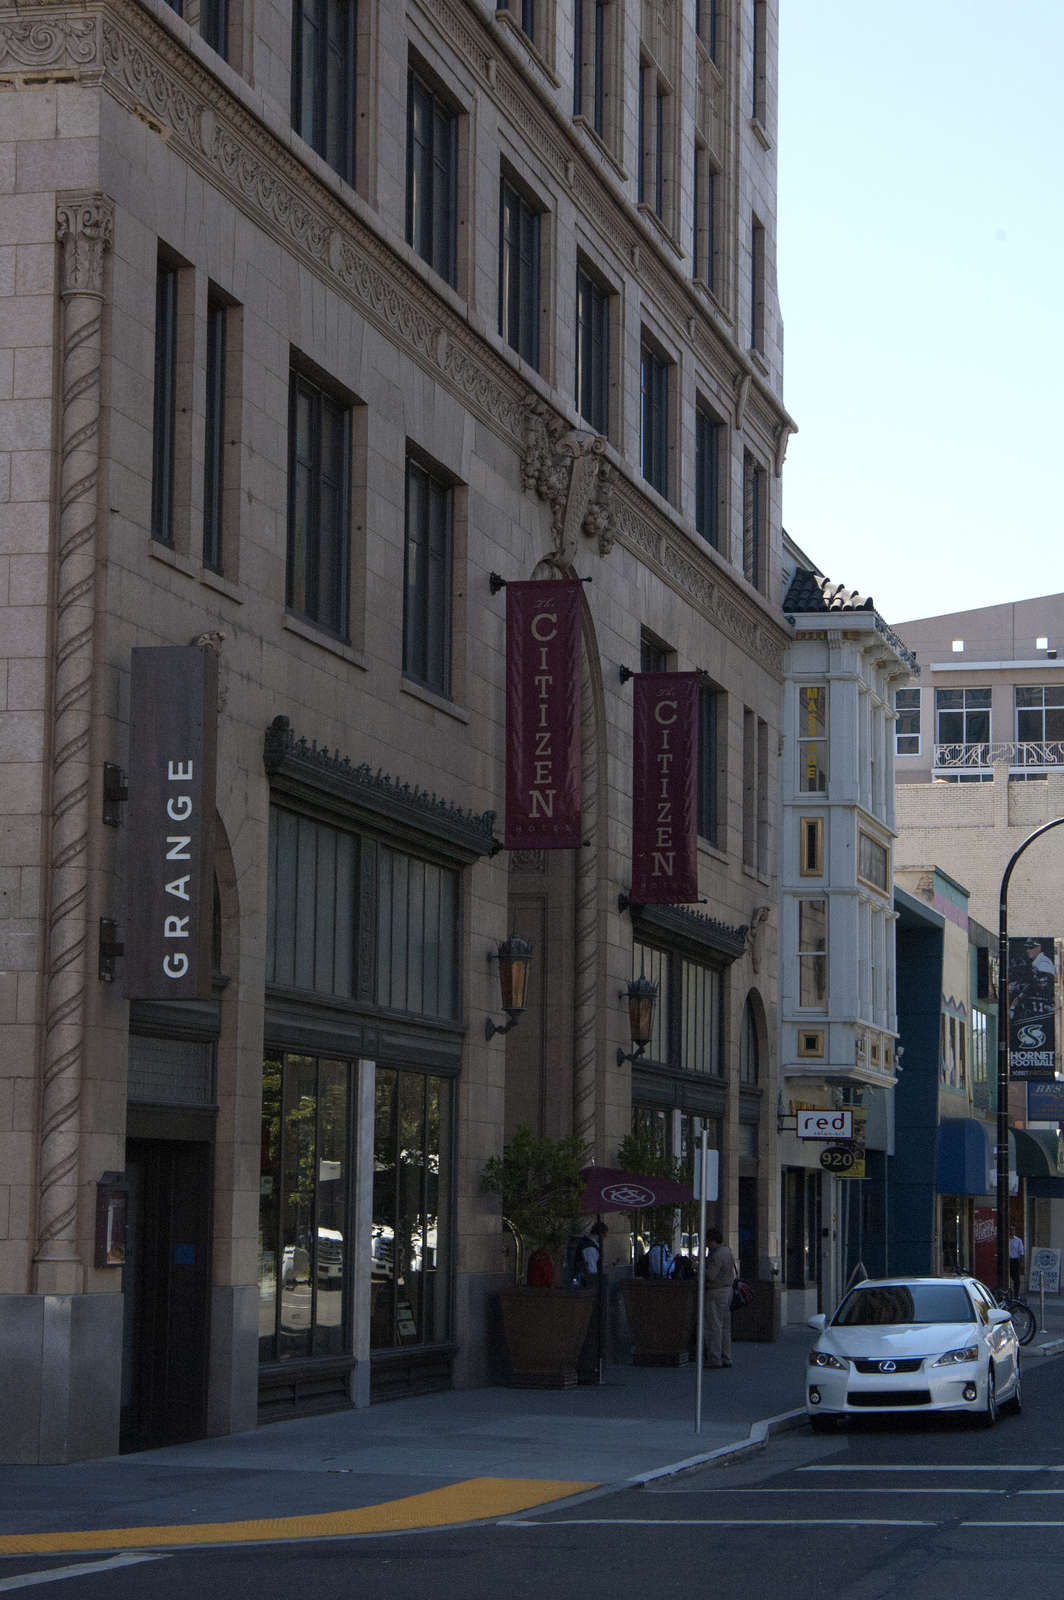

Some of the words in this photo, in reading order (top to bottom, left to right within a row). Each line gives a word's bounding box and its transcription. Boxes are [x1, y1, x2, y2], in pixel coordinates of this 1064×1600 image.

[529, 612, 558, 819] CITIZEN
[652, 700, 679, 876] CITIZEN
[162, 759, 193, 978] GRANGE
[1010, 1051, 1055, 1060] HORNET
[1010, 1059, 1055, 1067] FOOTBALL
[804, 1113, 845, 1130] red
[822, 1152, 853, 1166] 920
